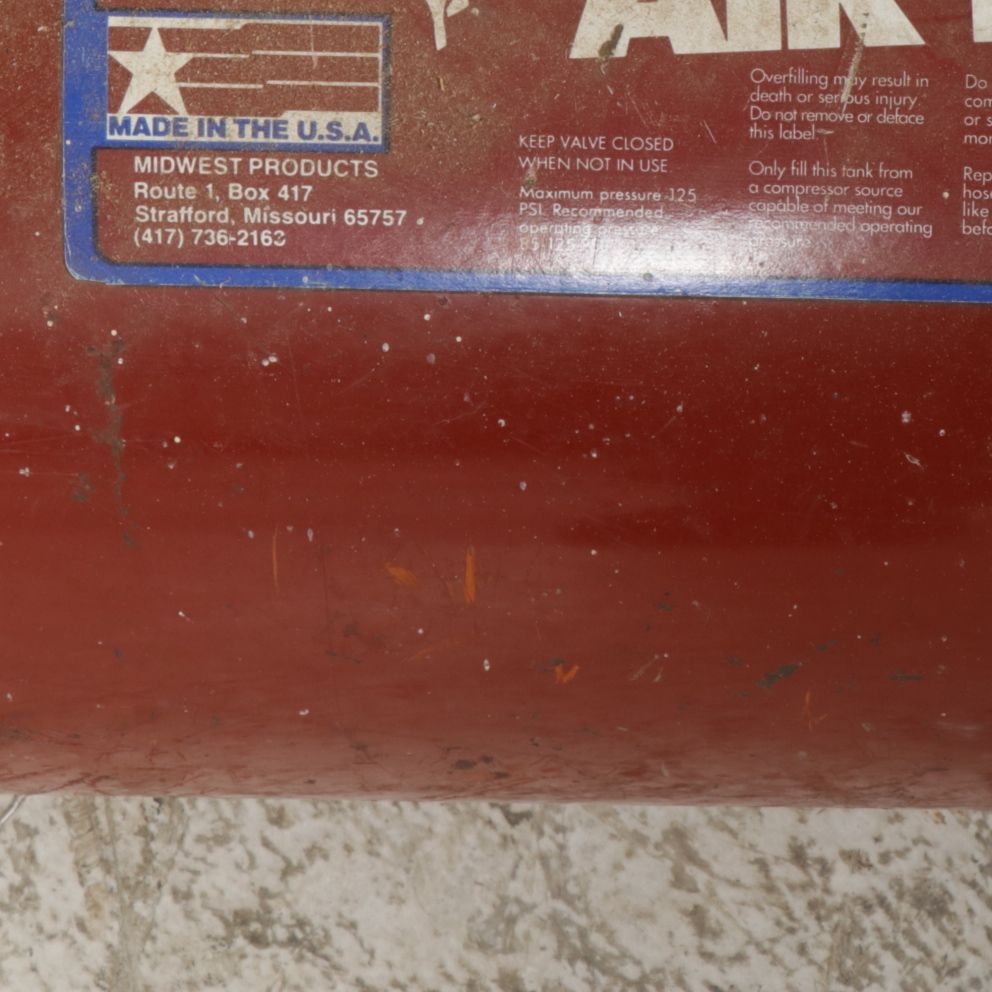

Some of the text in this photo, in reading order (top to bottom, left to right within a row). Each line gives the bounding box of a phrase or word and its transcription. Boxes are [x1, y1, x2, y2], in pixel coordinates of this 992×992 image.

[751, 67, 929, 90] Overfilling result in
[965, 74, 987, 89] Do
[751, 85, 791, 102] death
[797, 92, 813, 103] or
[751, 106, 924, 125] Do not remove or deface
[964, 116, 981, 127] or
[108, 116, 380, 143] MADE IN THE U.S.A.
[750, 122, 774, 139] this
[519, 135, 674, 151] KEEP VALVE CLOSED
[134, 156, 378, 178] MIDWEST PRODUCTS
[519, 157, 668, 173] WHEN NOT USE
[749, 159, 912, 180] Only fill this tank from
[134, 182, 312, 203] Route 1, Box 417
[519, 186, 696, 205] Maximum pressure 125
[764, 184, 903, 202] compressor source
[134, 206, 407, 227] Strafford, Missouri 65757
[553, 203, 663, 218] Recommended
[749, 196, 923, 219] capable meeting our
[963, 201, 989, 218] like
[750, 216, 932, 238] recommended operating
[133, 228, 286, 248] (417) 736-2163
